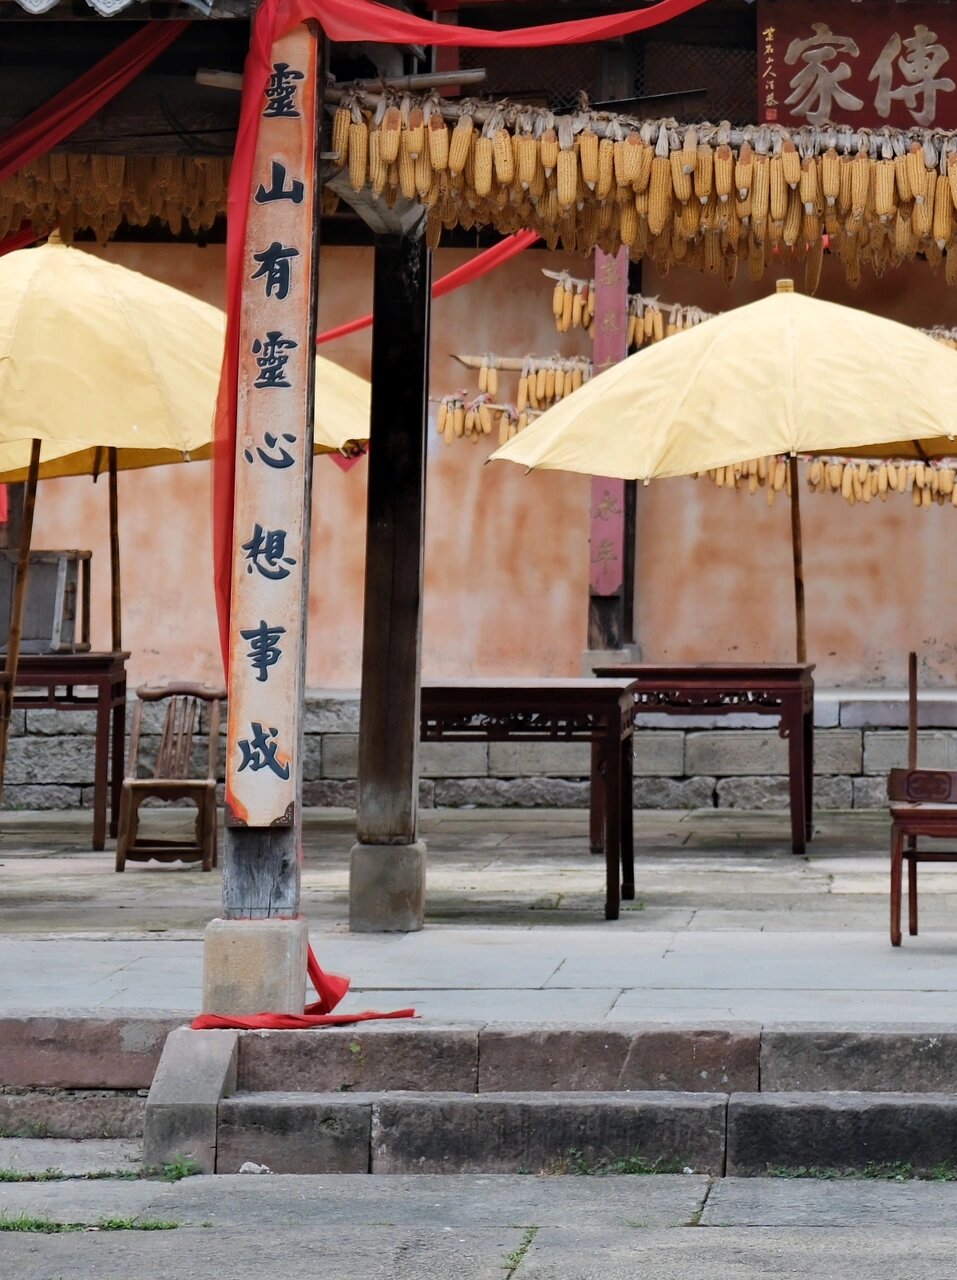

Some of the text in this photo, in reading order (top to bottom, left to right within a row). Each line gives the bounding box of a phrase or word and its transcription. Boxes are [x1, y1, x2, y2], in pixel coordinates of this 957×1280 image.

[236, 62, 305, 781] 靈山有靈心想事成
